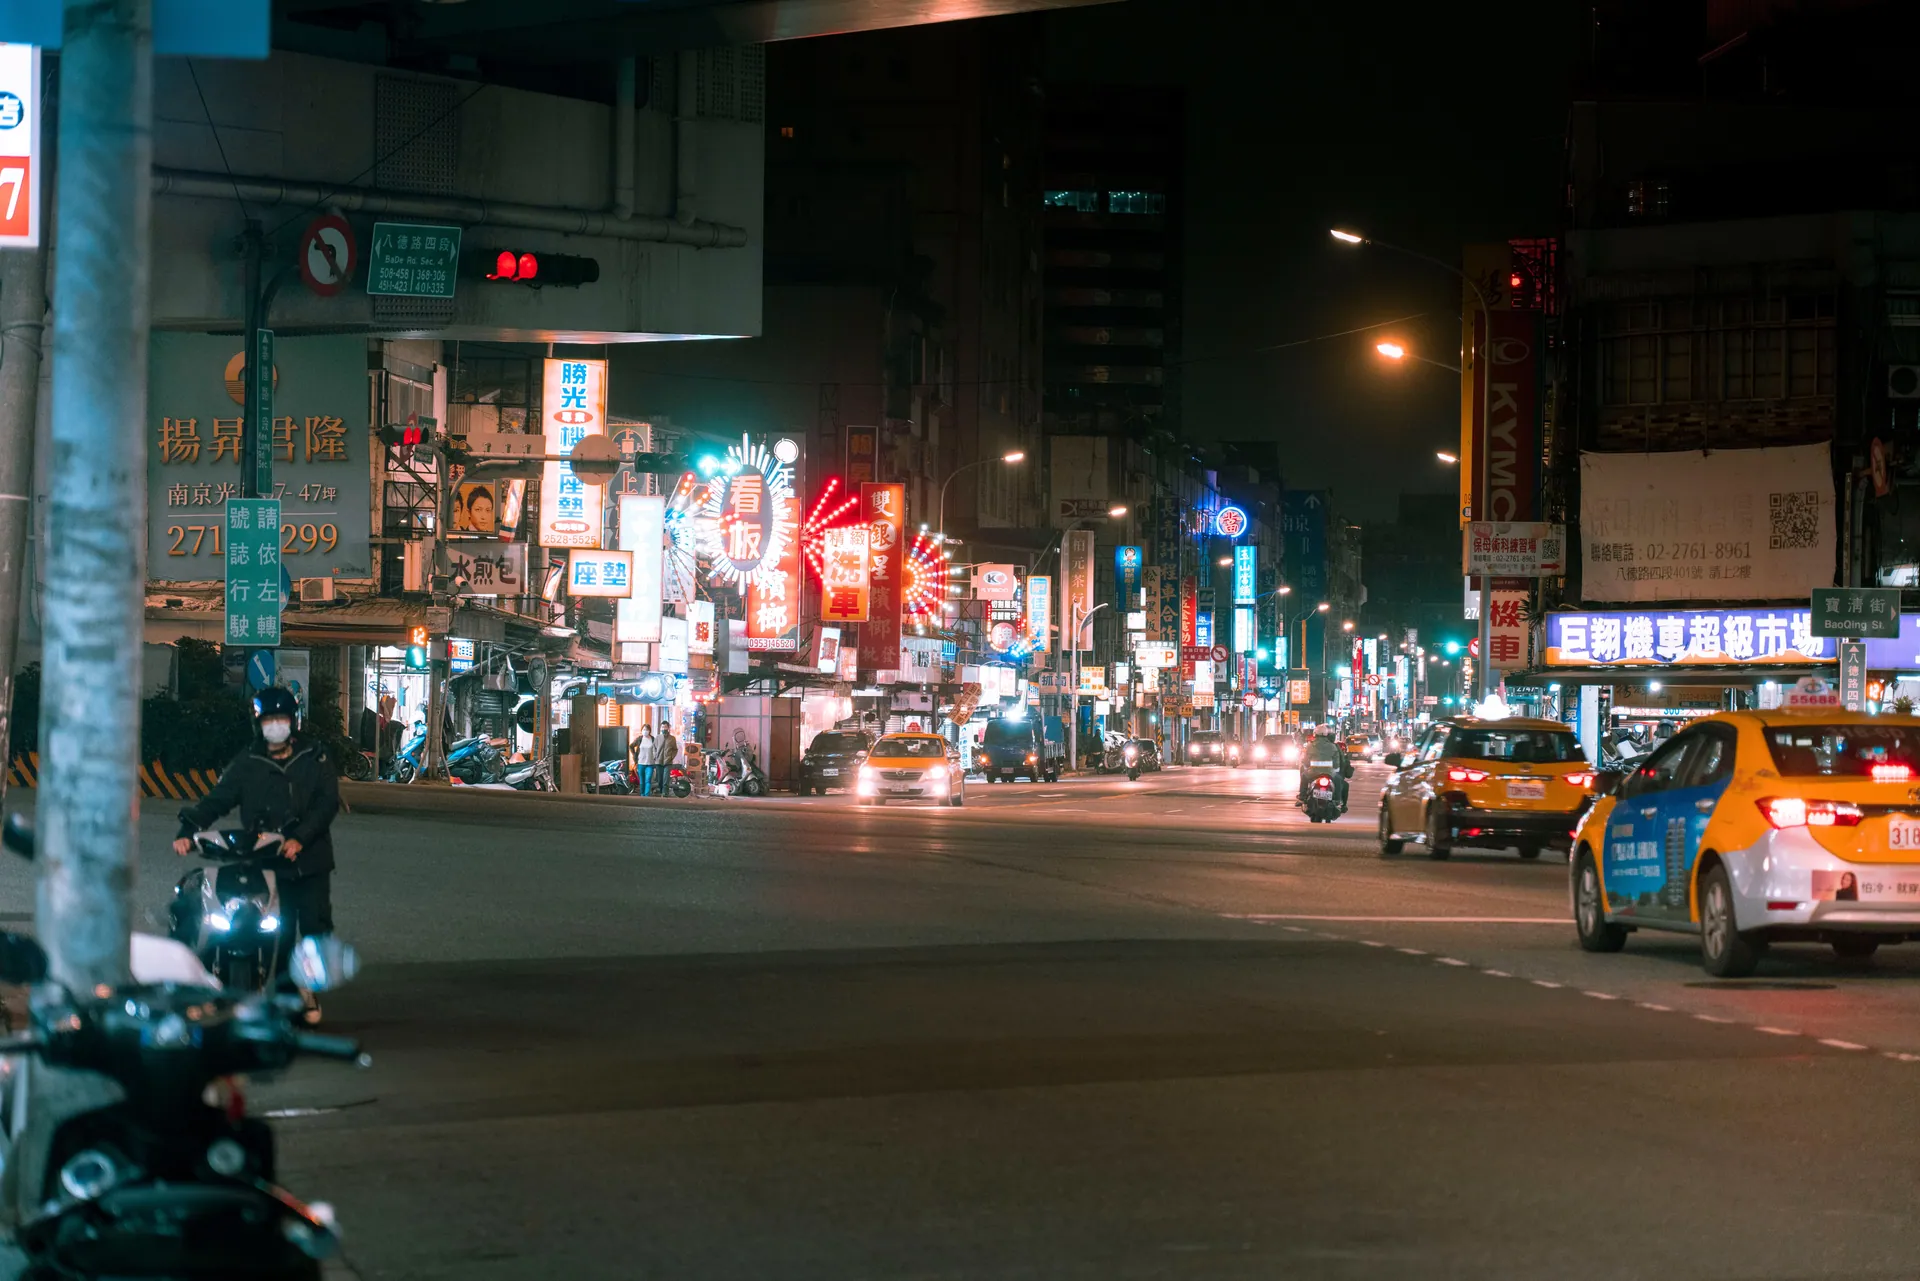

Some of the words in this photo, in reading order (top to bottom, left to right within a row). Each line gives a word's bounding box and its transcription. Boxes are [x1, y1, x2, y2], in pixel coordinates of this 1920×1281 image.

[383, 234, 450, 252] 八德路四段
[385, 255, 403, 264] BaDe
[437, 258, 443, 266] 4
[380, 268, 409, 279] 508-458
[417, 269, 446, 281] 368-306
[415, 282, 445, 293] 401-335
[561, 363, 588, 409] 勝光
[158, 415, 350, 466] 揚昇君隆
[1491, 382, 1518, 523] KYMC
[559, 426, 586, 519] 機座墊
[168, 482, 246, 506] 南京光
[728, 474, 764, 561] 看板
[1219, 510, 1243, 534] 當
[544, 534, 597, 545] 2528-5525
[829, 532, 865, 547] 精緻
[1473, 538, 1537, 553] 保母術科練習場
[1647, 542, 1752, 561] 02-2761-8961
[451, 555, 517, 585] 水煎包
[866, 491, 896, 640] 雙銀星檳榔
[1496, 555, 1536, 563] 02-2761-8961
[230, 506, 250, 638] 號誌行駛
[257, 506, 277, 638] 請依左轉
[574, 562, 627, 586] 座墊
[829, 550, 861, 618] 洗車
[1825, 597, 1885, 613] 寶清街
[1490, 600, 1520, 661] 機車
[1825, 619, 1867, 631] BaoQing
[749, 638, 795, 649] 0953146520
[1559, 615, 1824, 663] 巨翔機車超級市場
[1164, 651, 1175, 664] P
[1790, 695, 1838, 705] 55688
